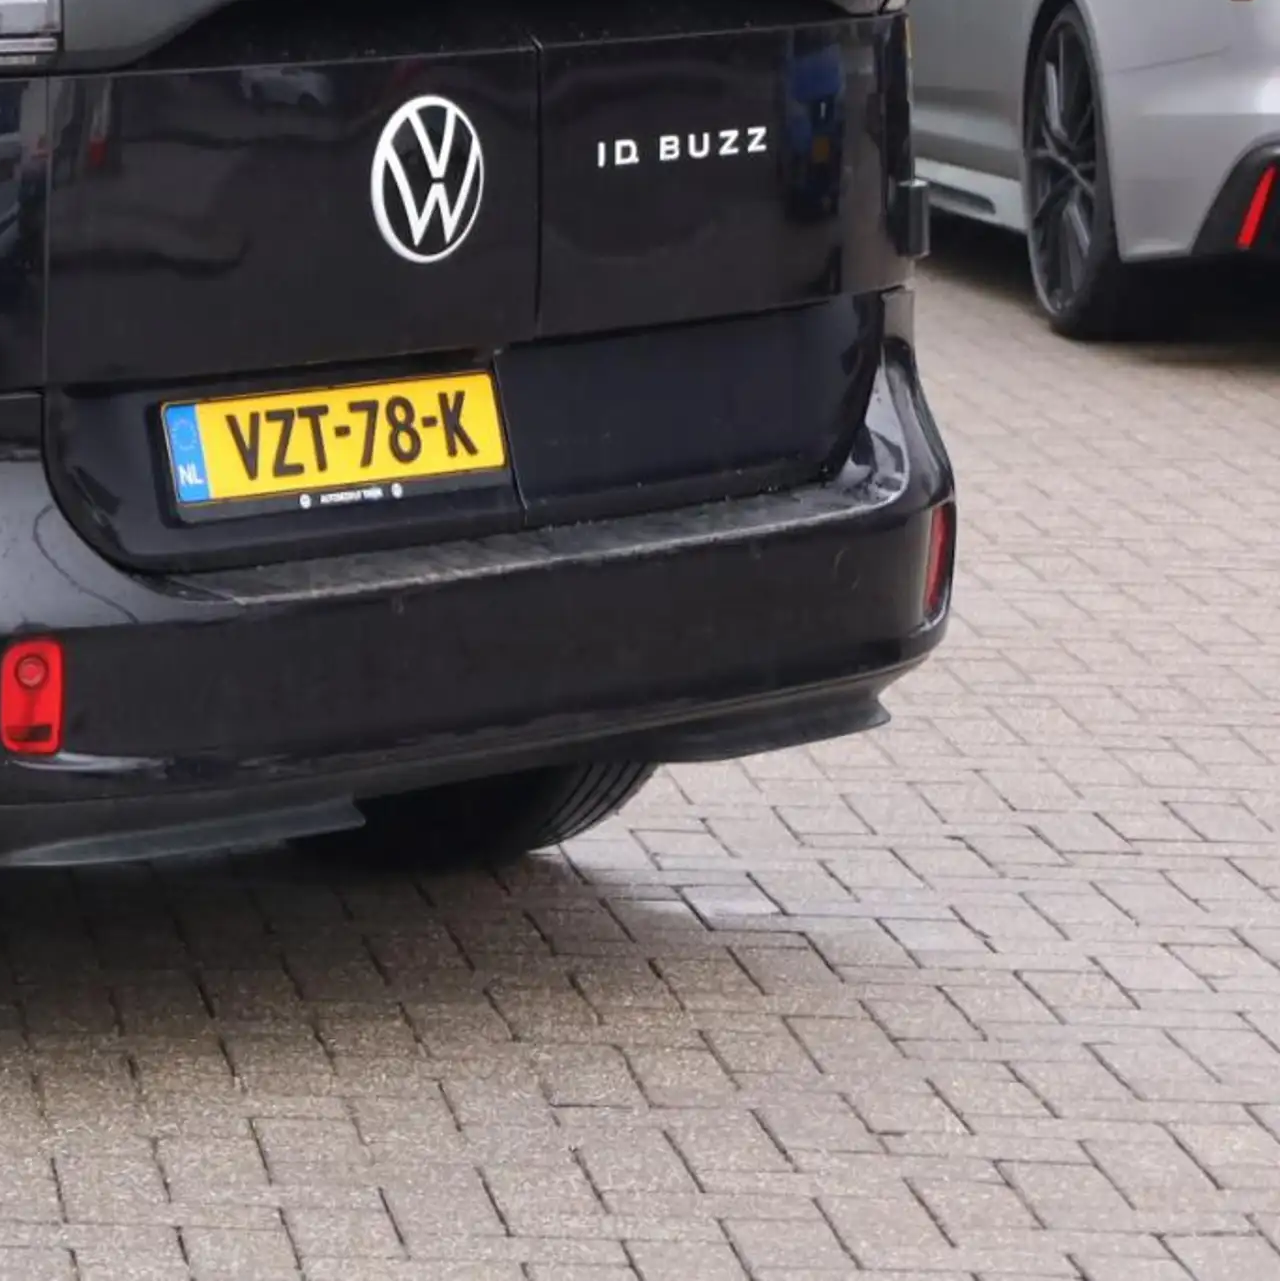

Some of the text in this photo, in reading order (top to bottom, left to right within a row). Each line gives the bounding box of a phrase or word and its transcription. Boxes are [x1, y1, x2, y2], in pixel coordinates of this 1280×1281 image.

[659, 125, 768, 162] BUZZ
[225, 389, 479, 481] VZT-78-K
[178, 464, 204, 486] NL
